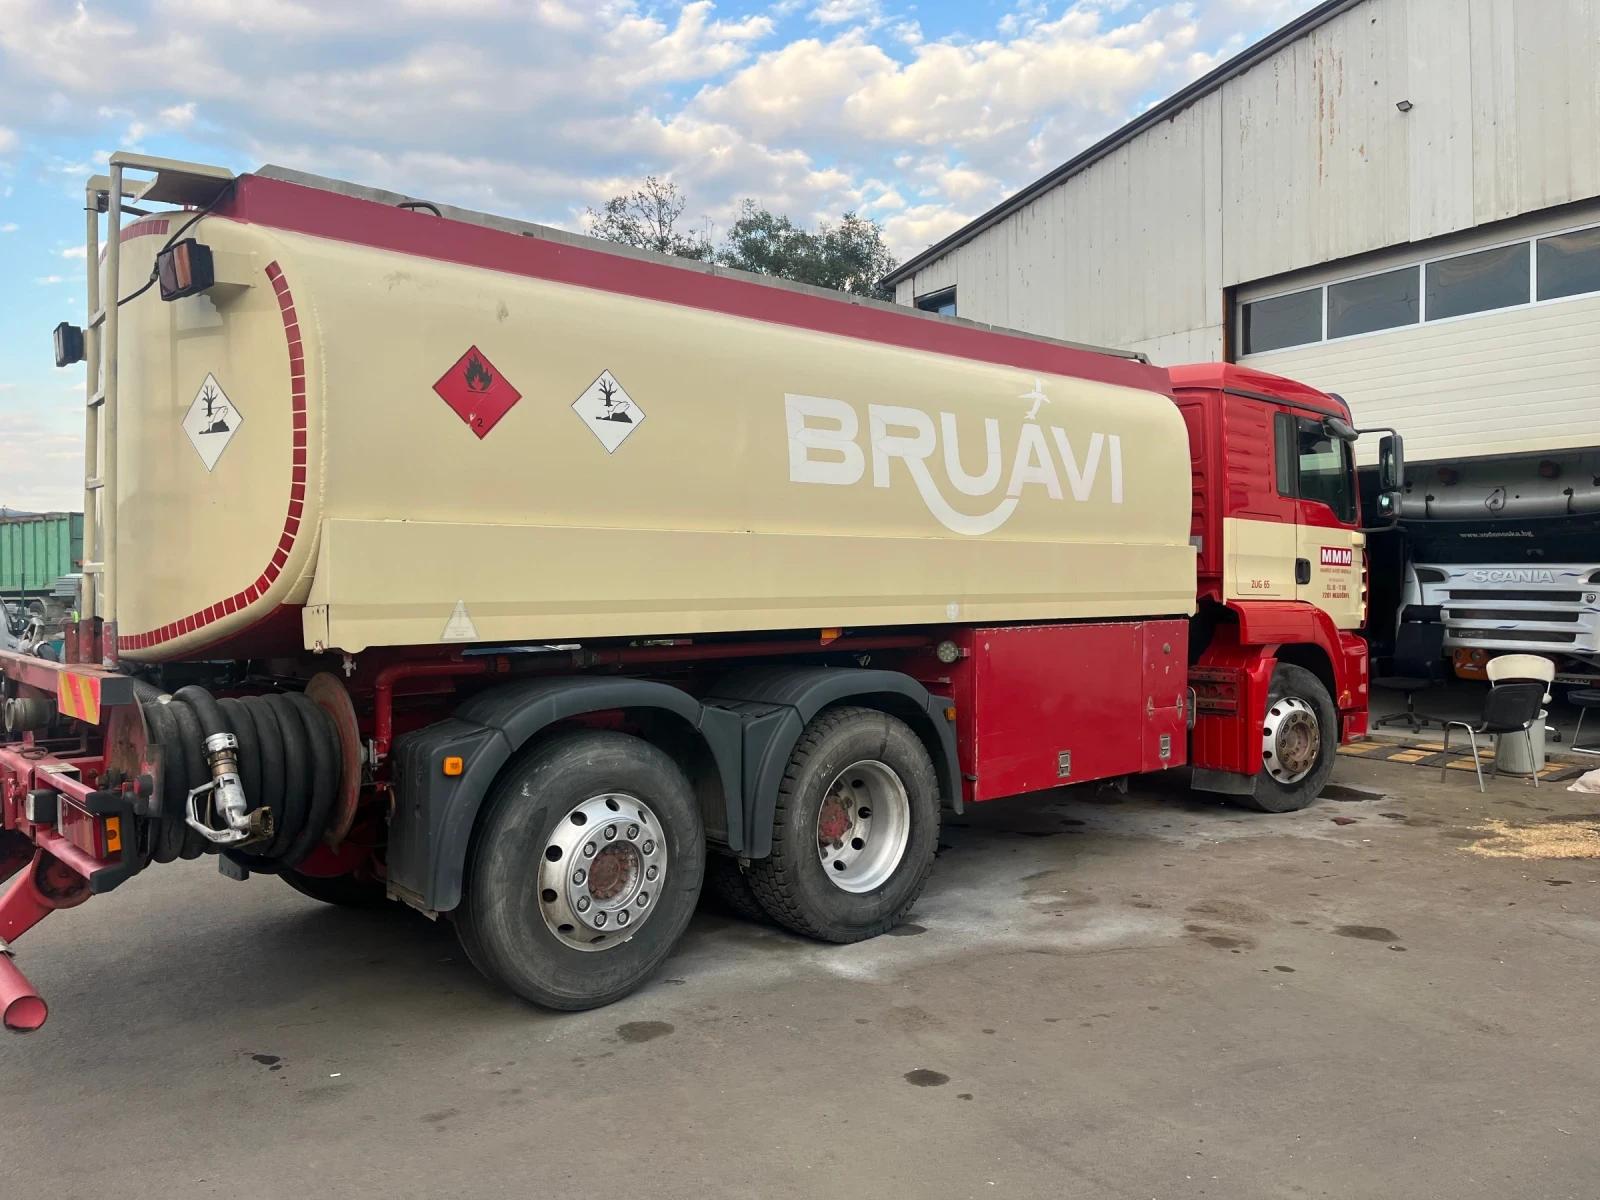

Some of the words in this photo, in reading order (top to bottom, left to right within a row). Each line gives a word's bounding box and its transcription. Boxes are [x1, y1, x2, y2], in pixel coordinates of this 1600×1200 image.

[477, 418, 484, 428] 2
[784, 392, 1123, 535] BRUAVI
[1322, 549, 1351, 564] MMM
[1473, 569, 1555, 583] SCANIA
[1251, 579, 1262, 589] ZUG
[1263, 580, 1270, 589] 65
